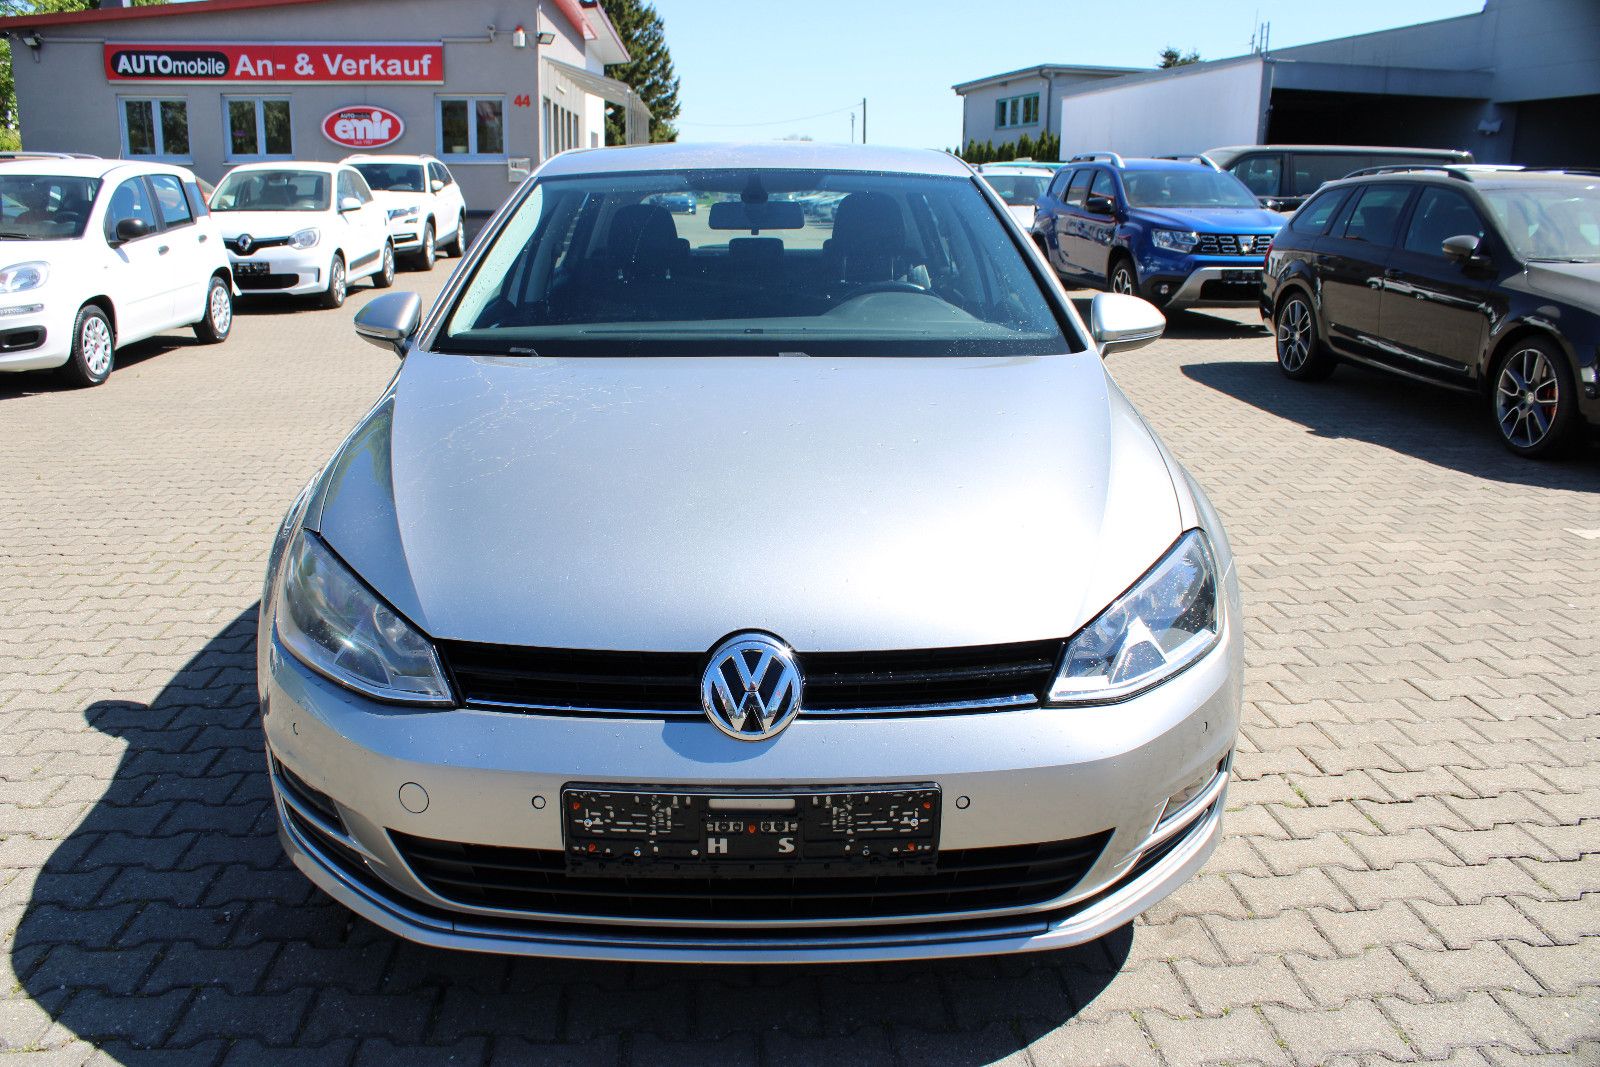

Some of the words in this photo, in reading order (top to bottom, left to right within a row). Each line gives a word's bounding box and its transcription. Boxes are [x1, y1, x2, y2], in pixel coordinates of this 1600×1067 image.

[117, 55, 226, 75] AUTOmobile
[234, 54, 286, 76] An-
[293, 53, 315, 75] &
[322, 53, 432, 76] Verkauf
[514, 95, 530, 107] 44
[334, 111, 391, 139] emir
